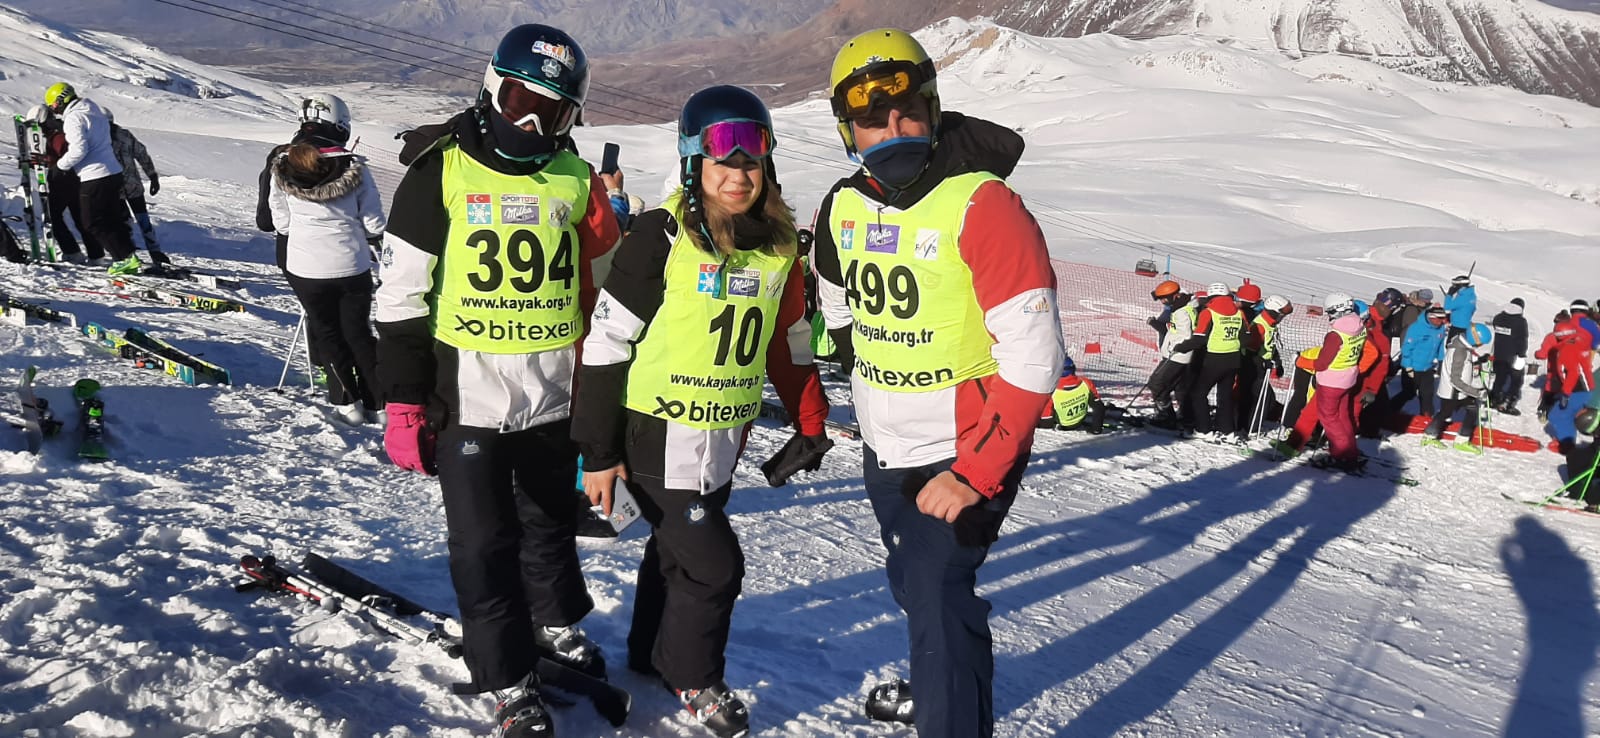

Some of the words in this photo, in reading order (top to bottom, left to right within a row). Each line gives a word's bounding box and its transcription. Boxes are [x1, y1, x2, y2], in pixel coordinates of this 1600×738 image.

[503, 206, 533, 220] Milka
[466, 229, 575, 293] 394
[845, 259, 920, 320] 499
[461, 296, 573, 312] www.kayak.org.tr
[489, 318, 578, 341] bitexen
[709, 304, 763, 367] 10
[670, 374, 760, 391] www.kayak.org.tr
[689, 400, 758, 422] bitexen
[1066, 402, 1086, 417] 479
